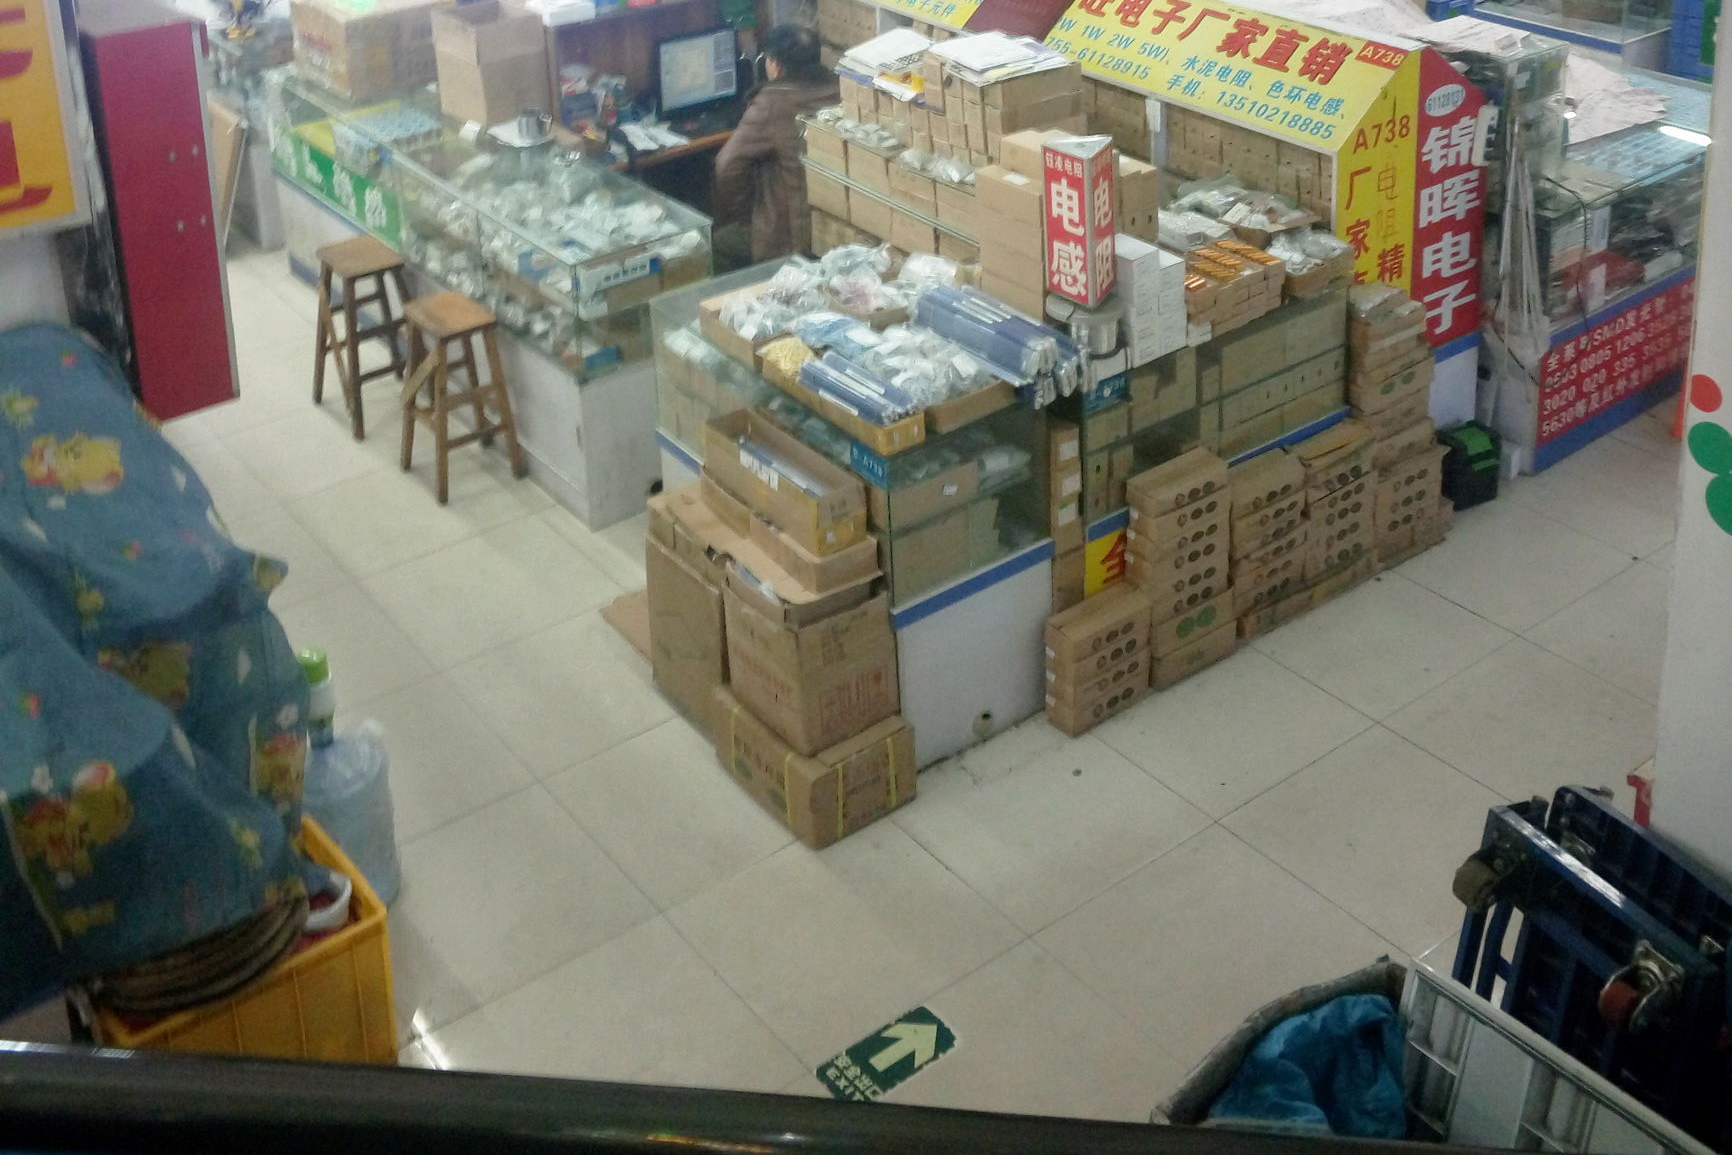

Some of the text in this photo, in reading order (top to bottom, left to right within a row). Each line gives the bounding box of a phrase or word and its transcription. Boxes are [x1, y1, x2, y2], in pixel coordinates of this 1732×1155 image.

[1361, 45, 1405, 66] A738
[1217, 91, 1337, 140] 13510218885
[1353, 115, 1411, 155] A738
[1050, 178, 1088, 296] 电感
